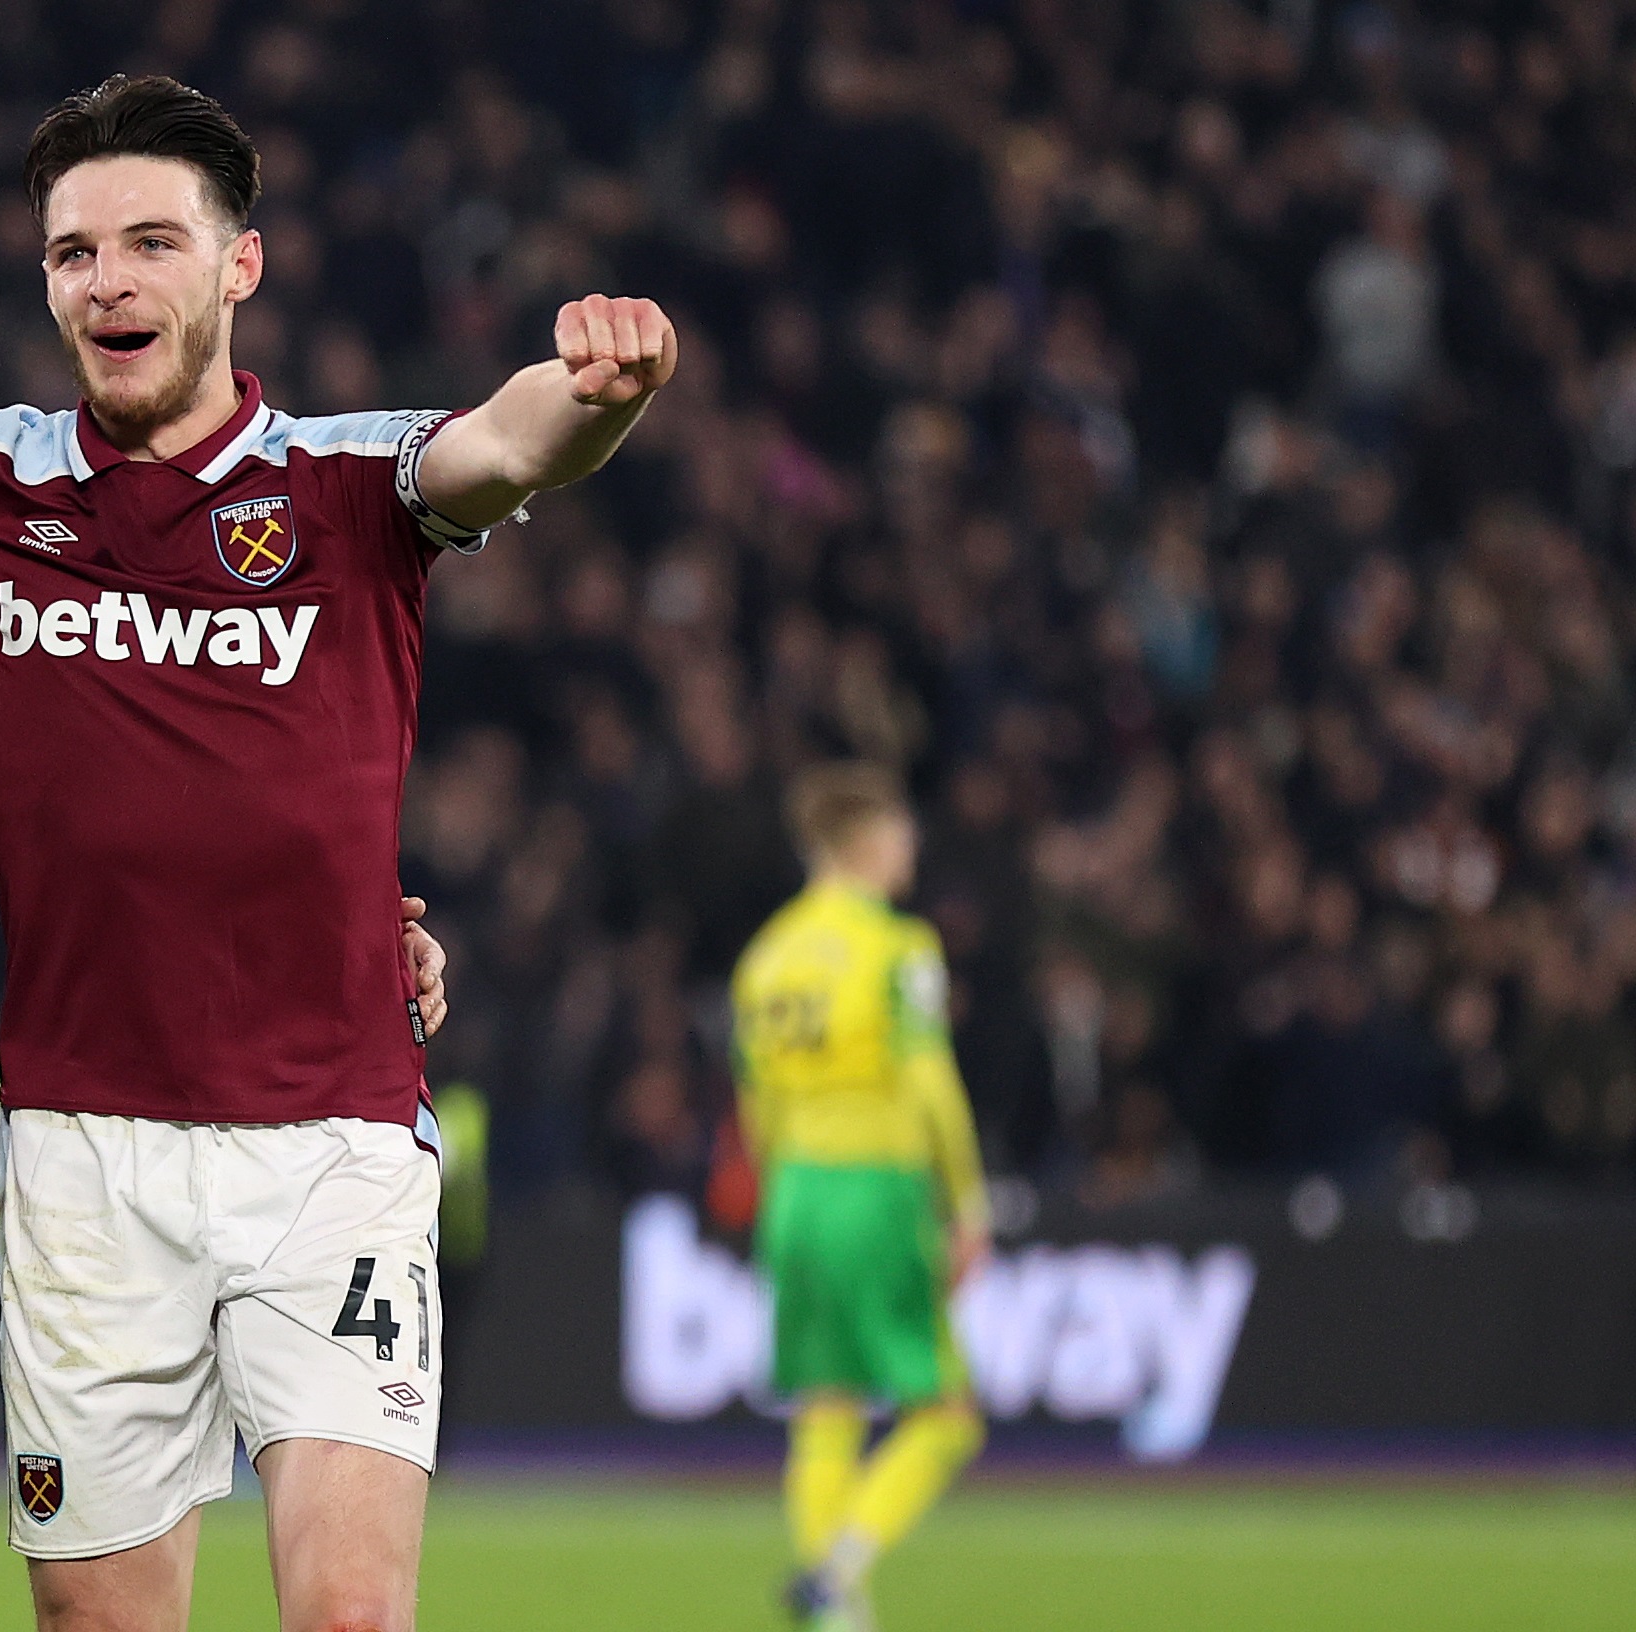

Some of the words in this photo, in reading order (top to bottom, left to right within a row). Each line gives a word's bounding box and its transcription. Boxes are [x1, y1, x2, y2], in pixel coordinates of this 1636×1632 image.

[220, 505, 252, 521] WEST
[253, 500, 284, 512] HAM
[234, 510, 271, 524] UNITED
[248, 566, 277, 578] LONDON
[331, 1257, 430, 1374] 41
[383, 1407, 420, 1426] umbro
[38, 1458, 57, 1468] HAM
